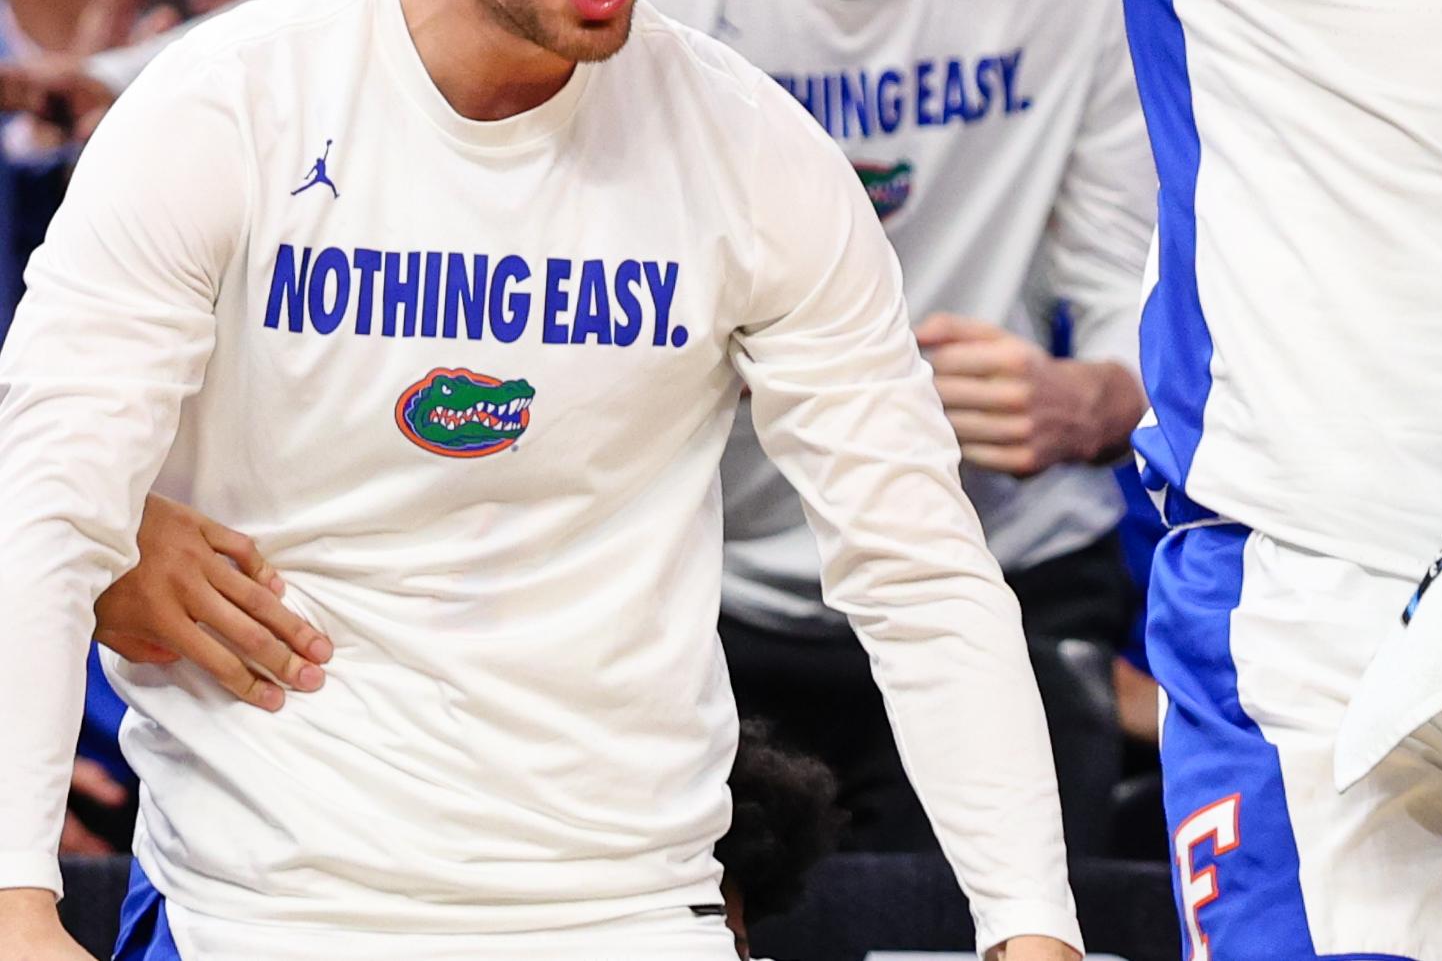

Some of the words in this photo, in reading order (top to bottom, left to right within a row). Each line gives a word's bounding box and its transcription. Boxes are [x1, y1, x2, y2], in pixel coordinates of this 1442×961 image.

[917, 48, 1032, 127] EASY.
[264, 243, 531, 343] NOTHING
[542, 258, 689, 348] EASY.
